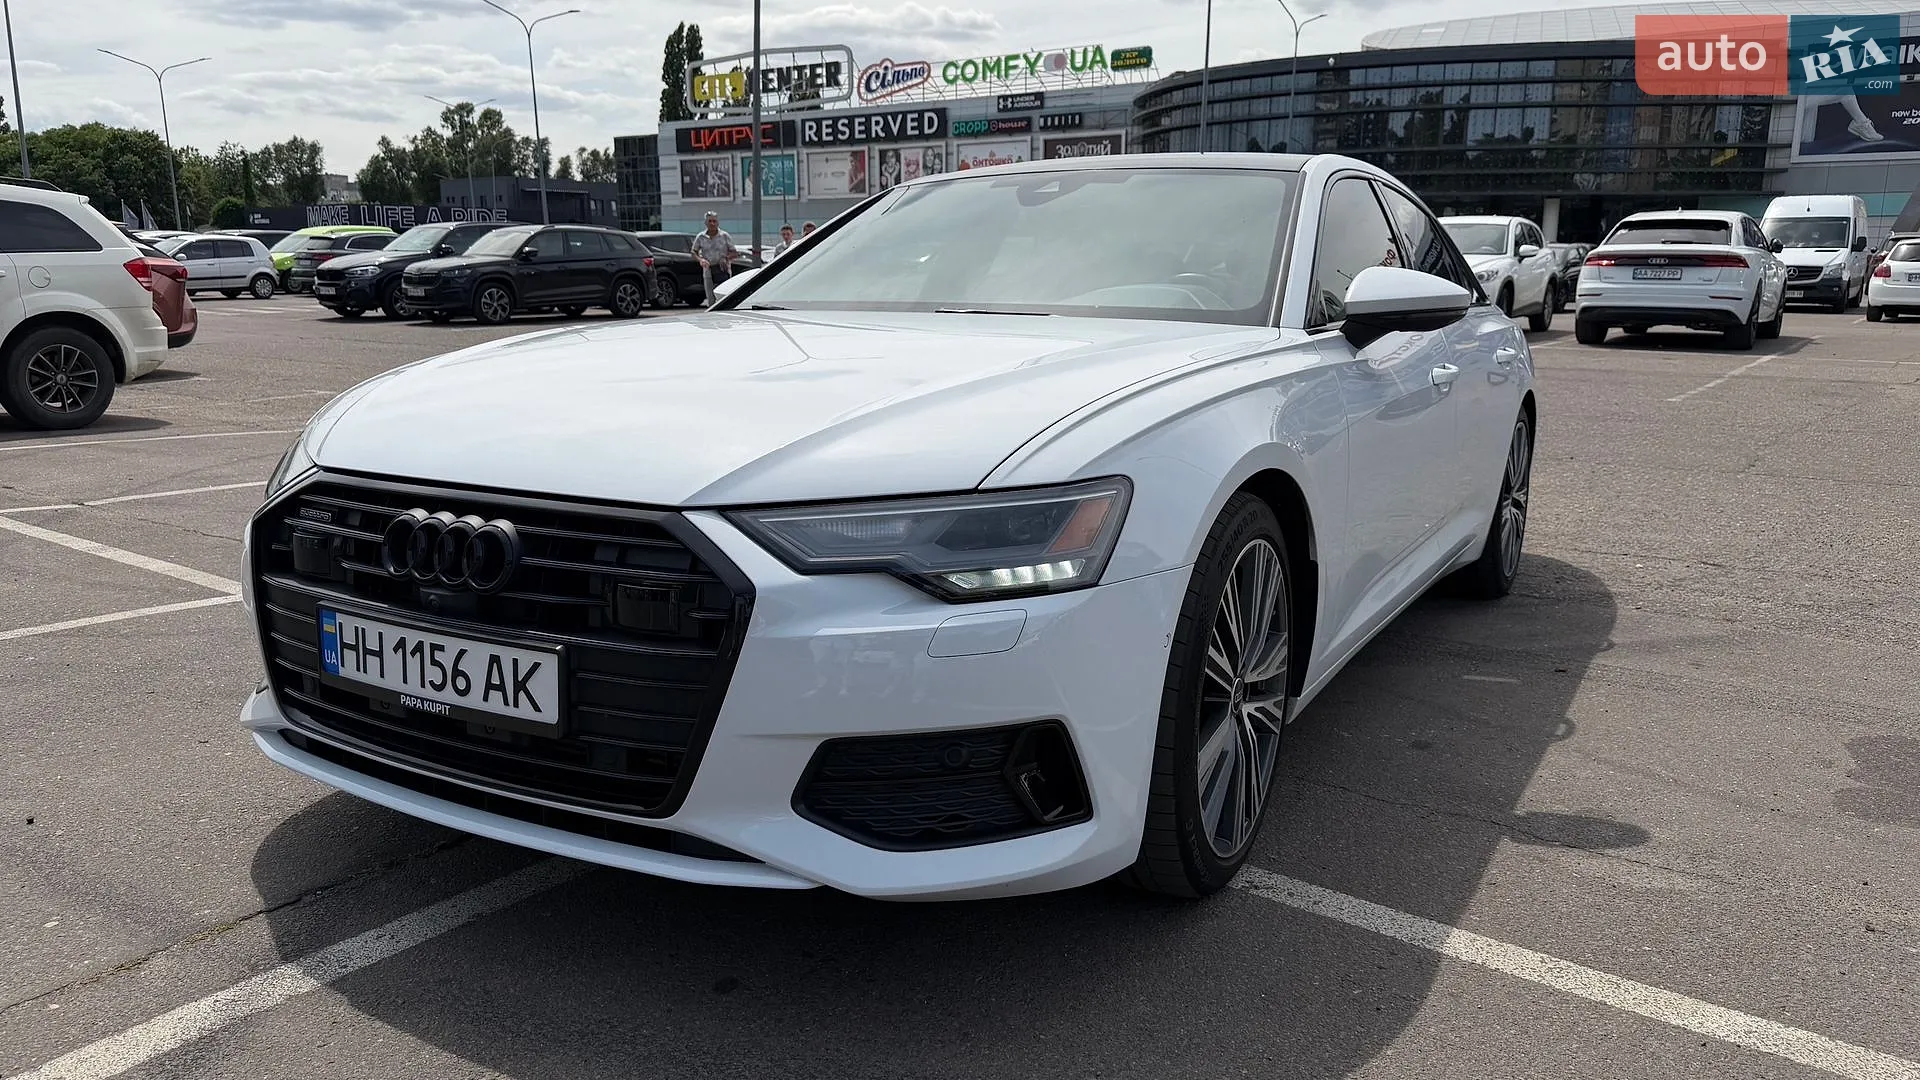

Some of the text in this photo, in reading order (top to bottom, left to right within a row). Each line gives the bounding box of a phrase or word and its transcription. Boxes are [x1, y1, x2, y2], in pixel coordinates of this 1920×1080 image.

[942, 44, 1108, 85] COMFY UA
[864, 65, 925, 93] Сільпо
[805, 111, 938, 142] RESERVED
[953, 120, 988, 134] CROPP
[306, 204, 350, 228] MAKE
[360, 205, 416, 229] LIFE
[426, 206, 443, 224] A
[324, 649, 338, 666] UA
[338, 621, 543, 713] HH 1156 AK
[400, 694, 451, 716] PAPA KUPIT
